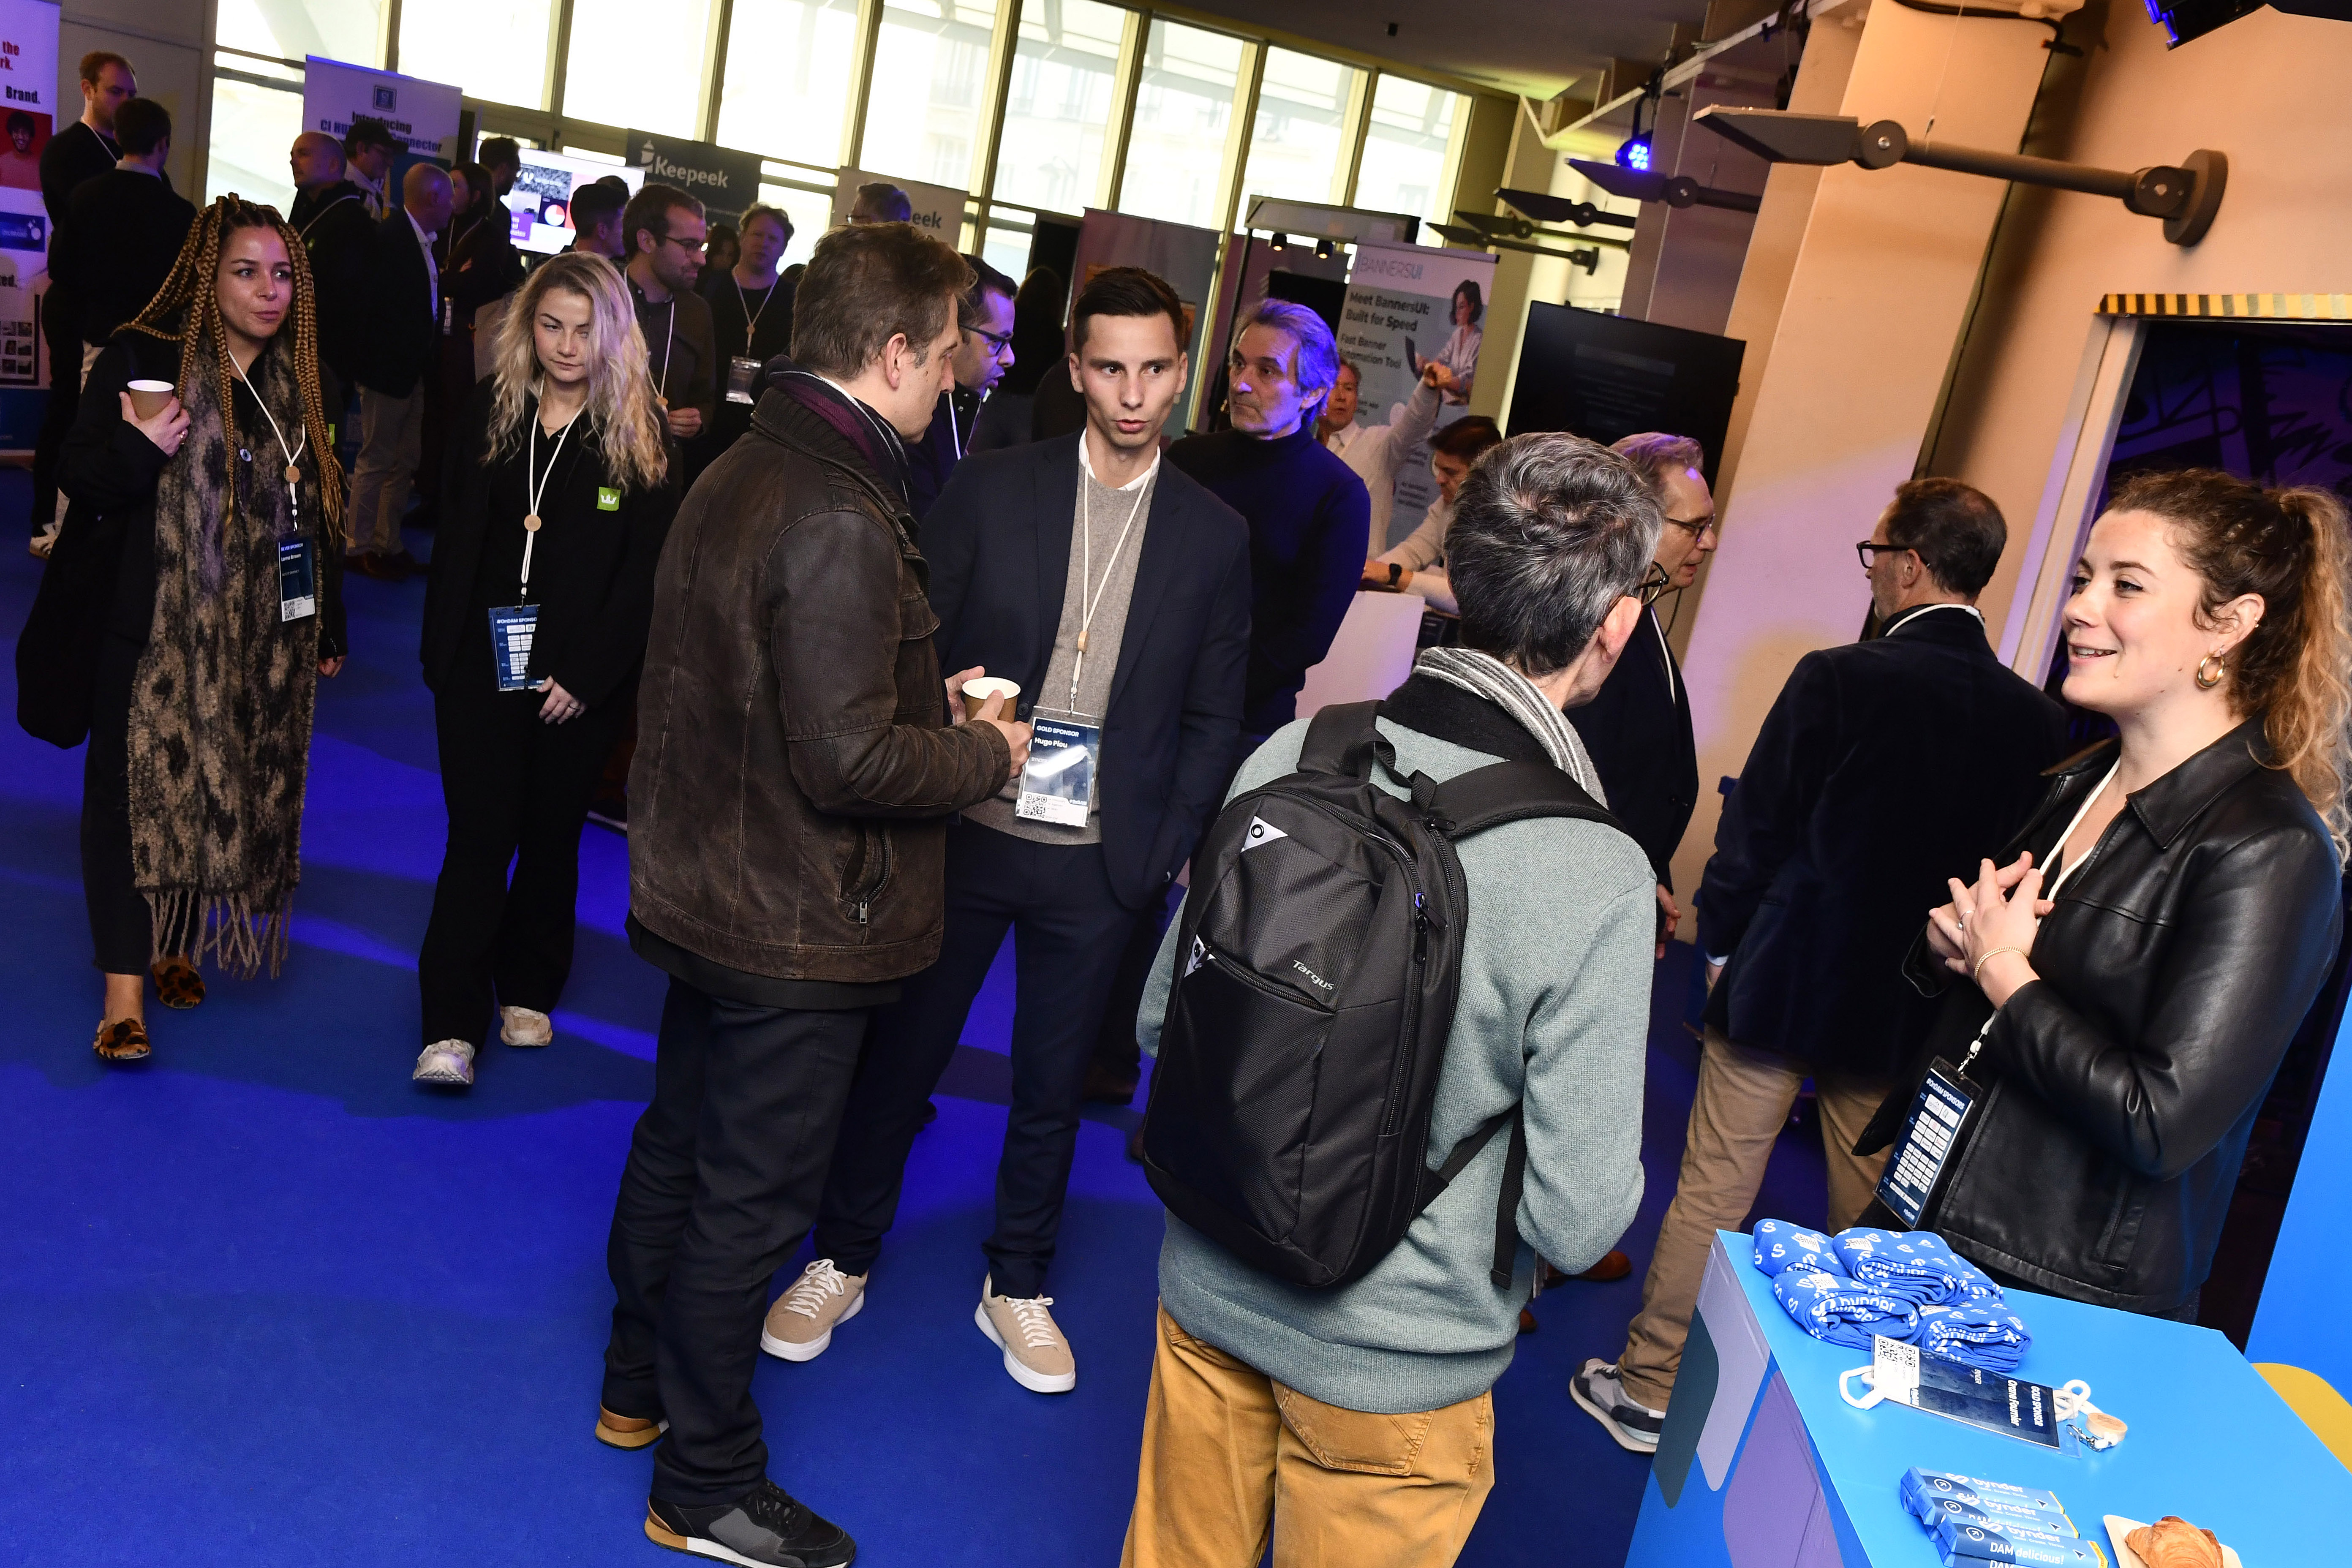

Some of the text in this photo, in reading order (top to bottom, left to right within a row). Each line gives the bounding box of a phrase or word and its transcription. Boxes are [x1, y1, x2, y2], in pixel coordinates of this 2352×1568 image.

[0, 56, 14, 71] rk.
[6, 86, 41, 104] Brand.
[655, 155, 729, 188] Keepeek
[913, 212, 942, 229] eek
[1386, 316, 1419, 332] Speed
[1037, 725, 1079, 738] GOLD SPONSOR
[1034, 737, 1068, 748] Hugo Piou
[1293, 959, 1334, 990] Targus
[1926, 1078, 1944, 1095] #OnDAM
[1942, 1090, 1965, 1110] SPONSORS
[2009, 1399, 2022, 1426] Fournier
[2031, 1386, 2044, 1427] GOLD SPONSOR
[1971, 1477, 2023, 1493] bynder
[1983, 1499, 2036, 1516] bynder
[2006, 1525, 2061, 1543] bynder
[1990, 1542, 2065, 1565] DAM delicious!
